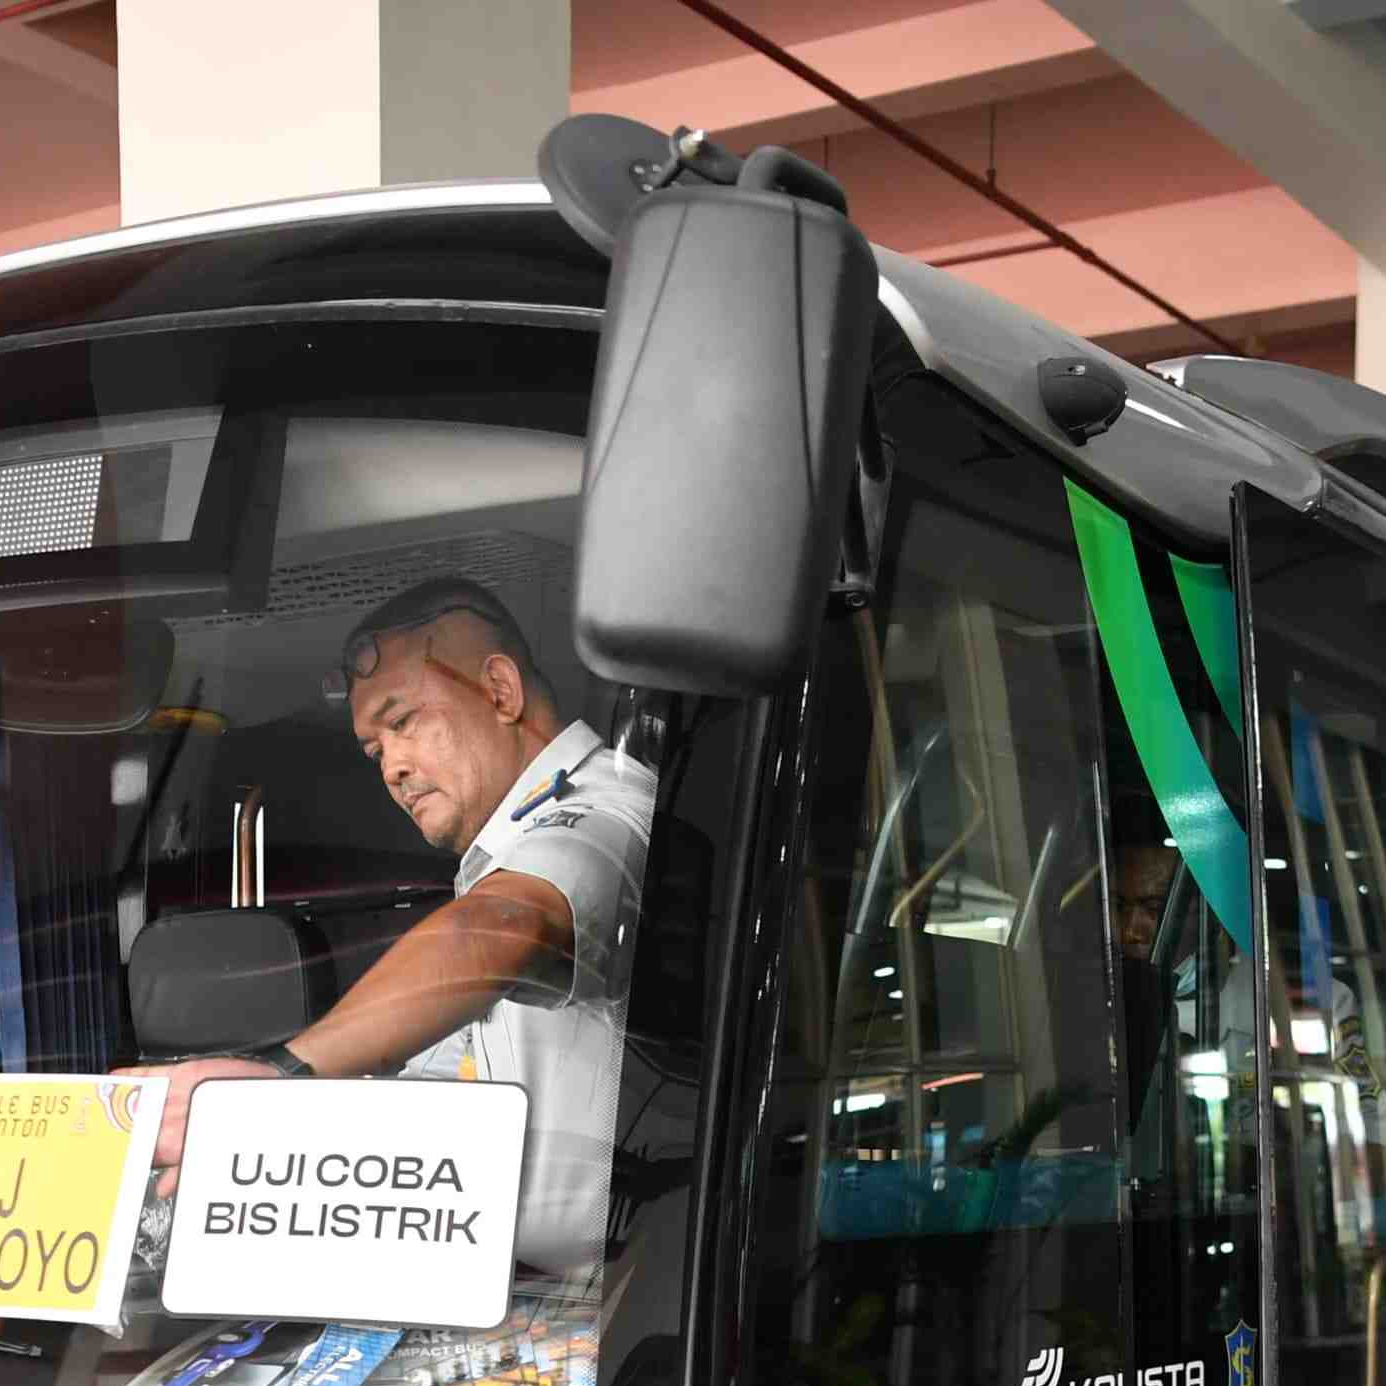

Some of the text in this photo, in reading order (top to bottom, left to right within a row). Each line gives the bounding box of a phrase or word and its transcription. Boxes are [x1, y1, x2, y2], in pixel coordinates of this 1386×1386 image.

[31, 1095, 72, 1116] BUS
[230, 1152, 464, 1193] UJI COBA
[203, 1201, 482, 1245] BIS LISTRIK
